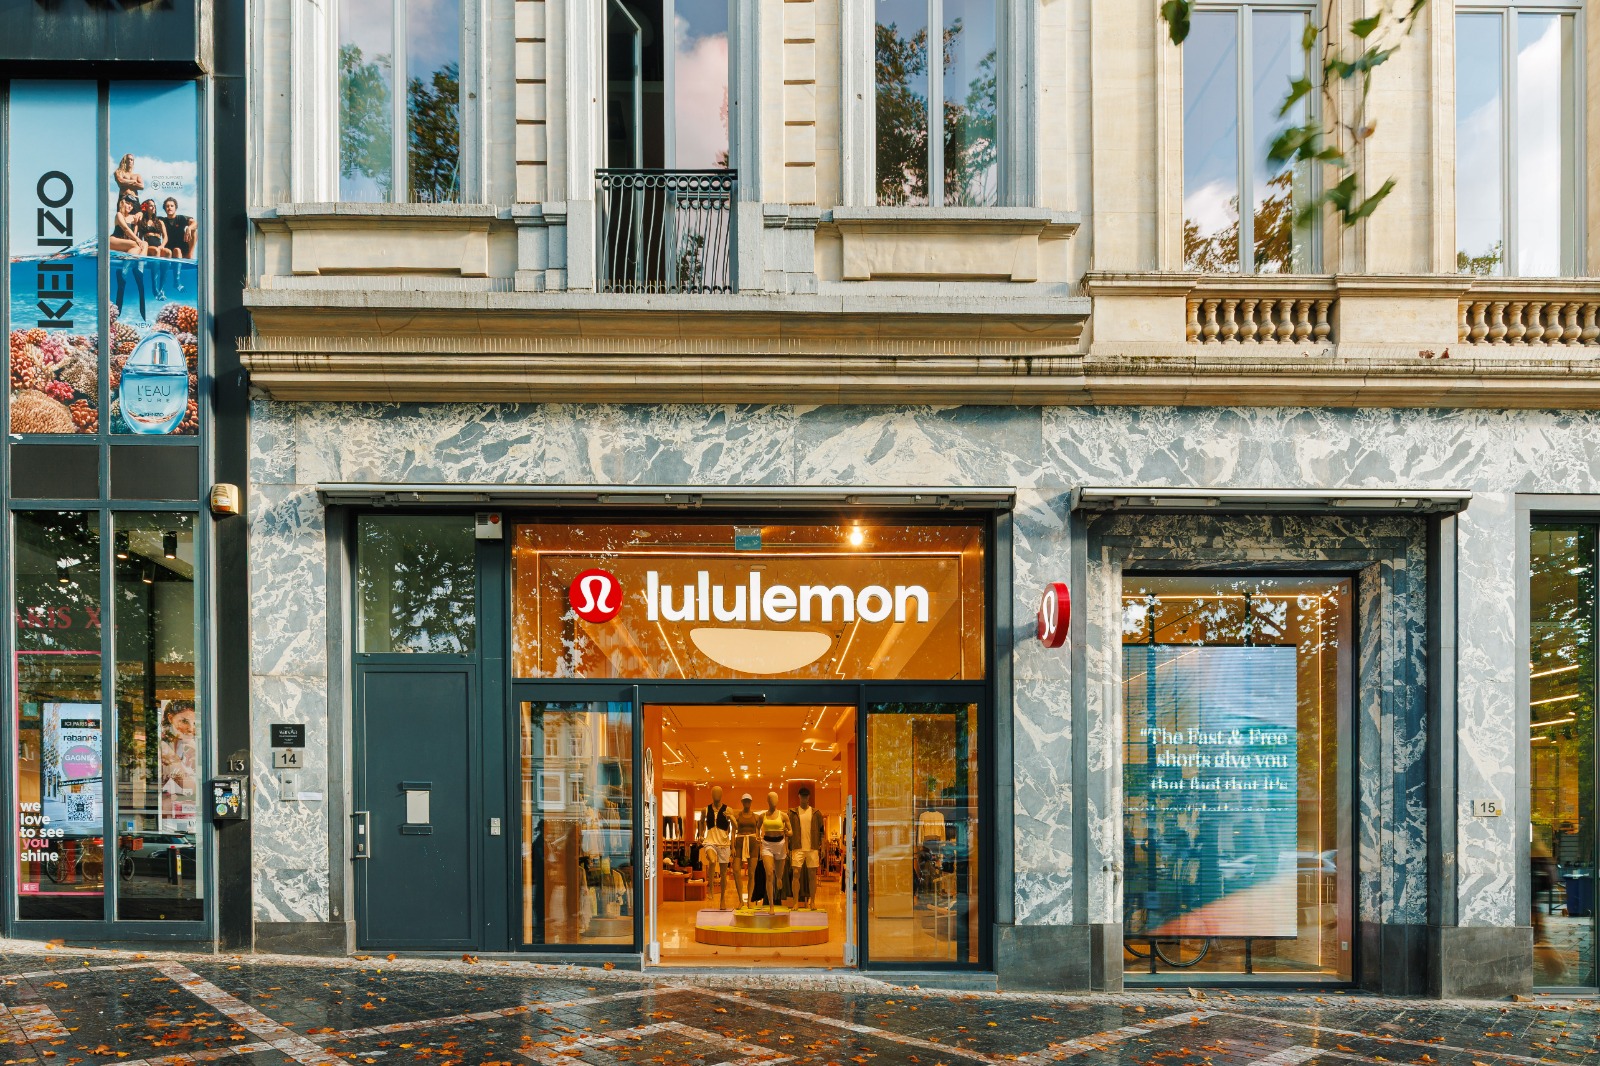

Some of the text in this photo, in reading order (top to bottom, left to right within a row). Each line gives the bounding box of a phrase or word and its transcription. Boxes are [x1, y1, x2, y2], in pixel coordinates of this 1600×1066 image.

[37, 170, 74, 328] KENZO
[646, 570, 930, 623] lululemon
[63, 734, 98, 742] rabanne
[1187, 727, 1225, 745] Fast
[1227, 727, 1246, 746] &
[1248, 728, 1288, 746] Free
[281, 753, 297, 765] 14
[1156, 749, 1212, 768] shorts
[229, 759, 245, 772] 13
[20, 802, 41, 812] we
[1480, 802, 1496, 813] 15
[20, 813, 51, 825] love
[20, 827, 65, 838] to see
[23, 839, 50, 850] you
[20, 850, 59, 862] shine
